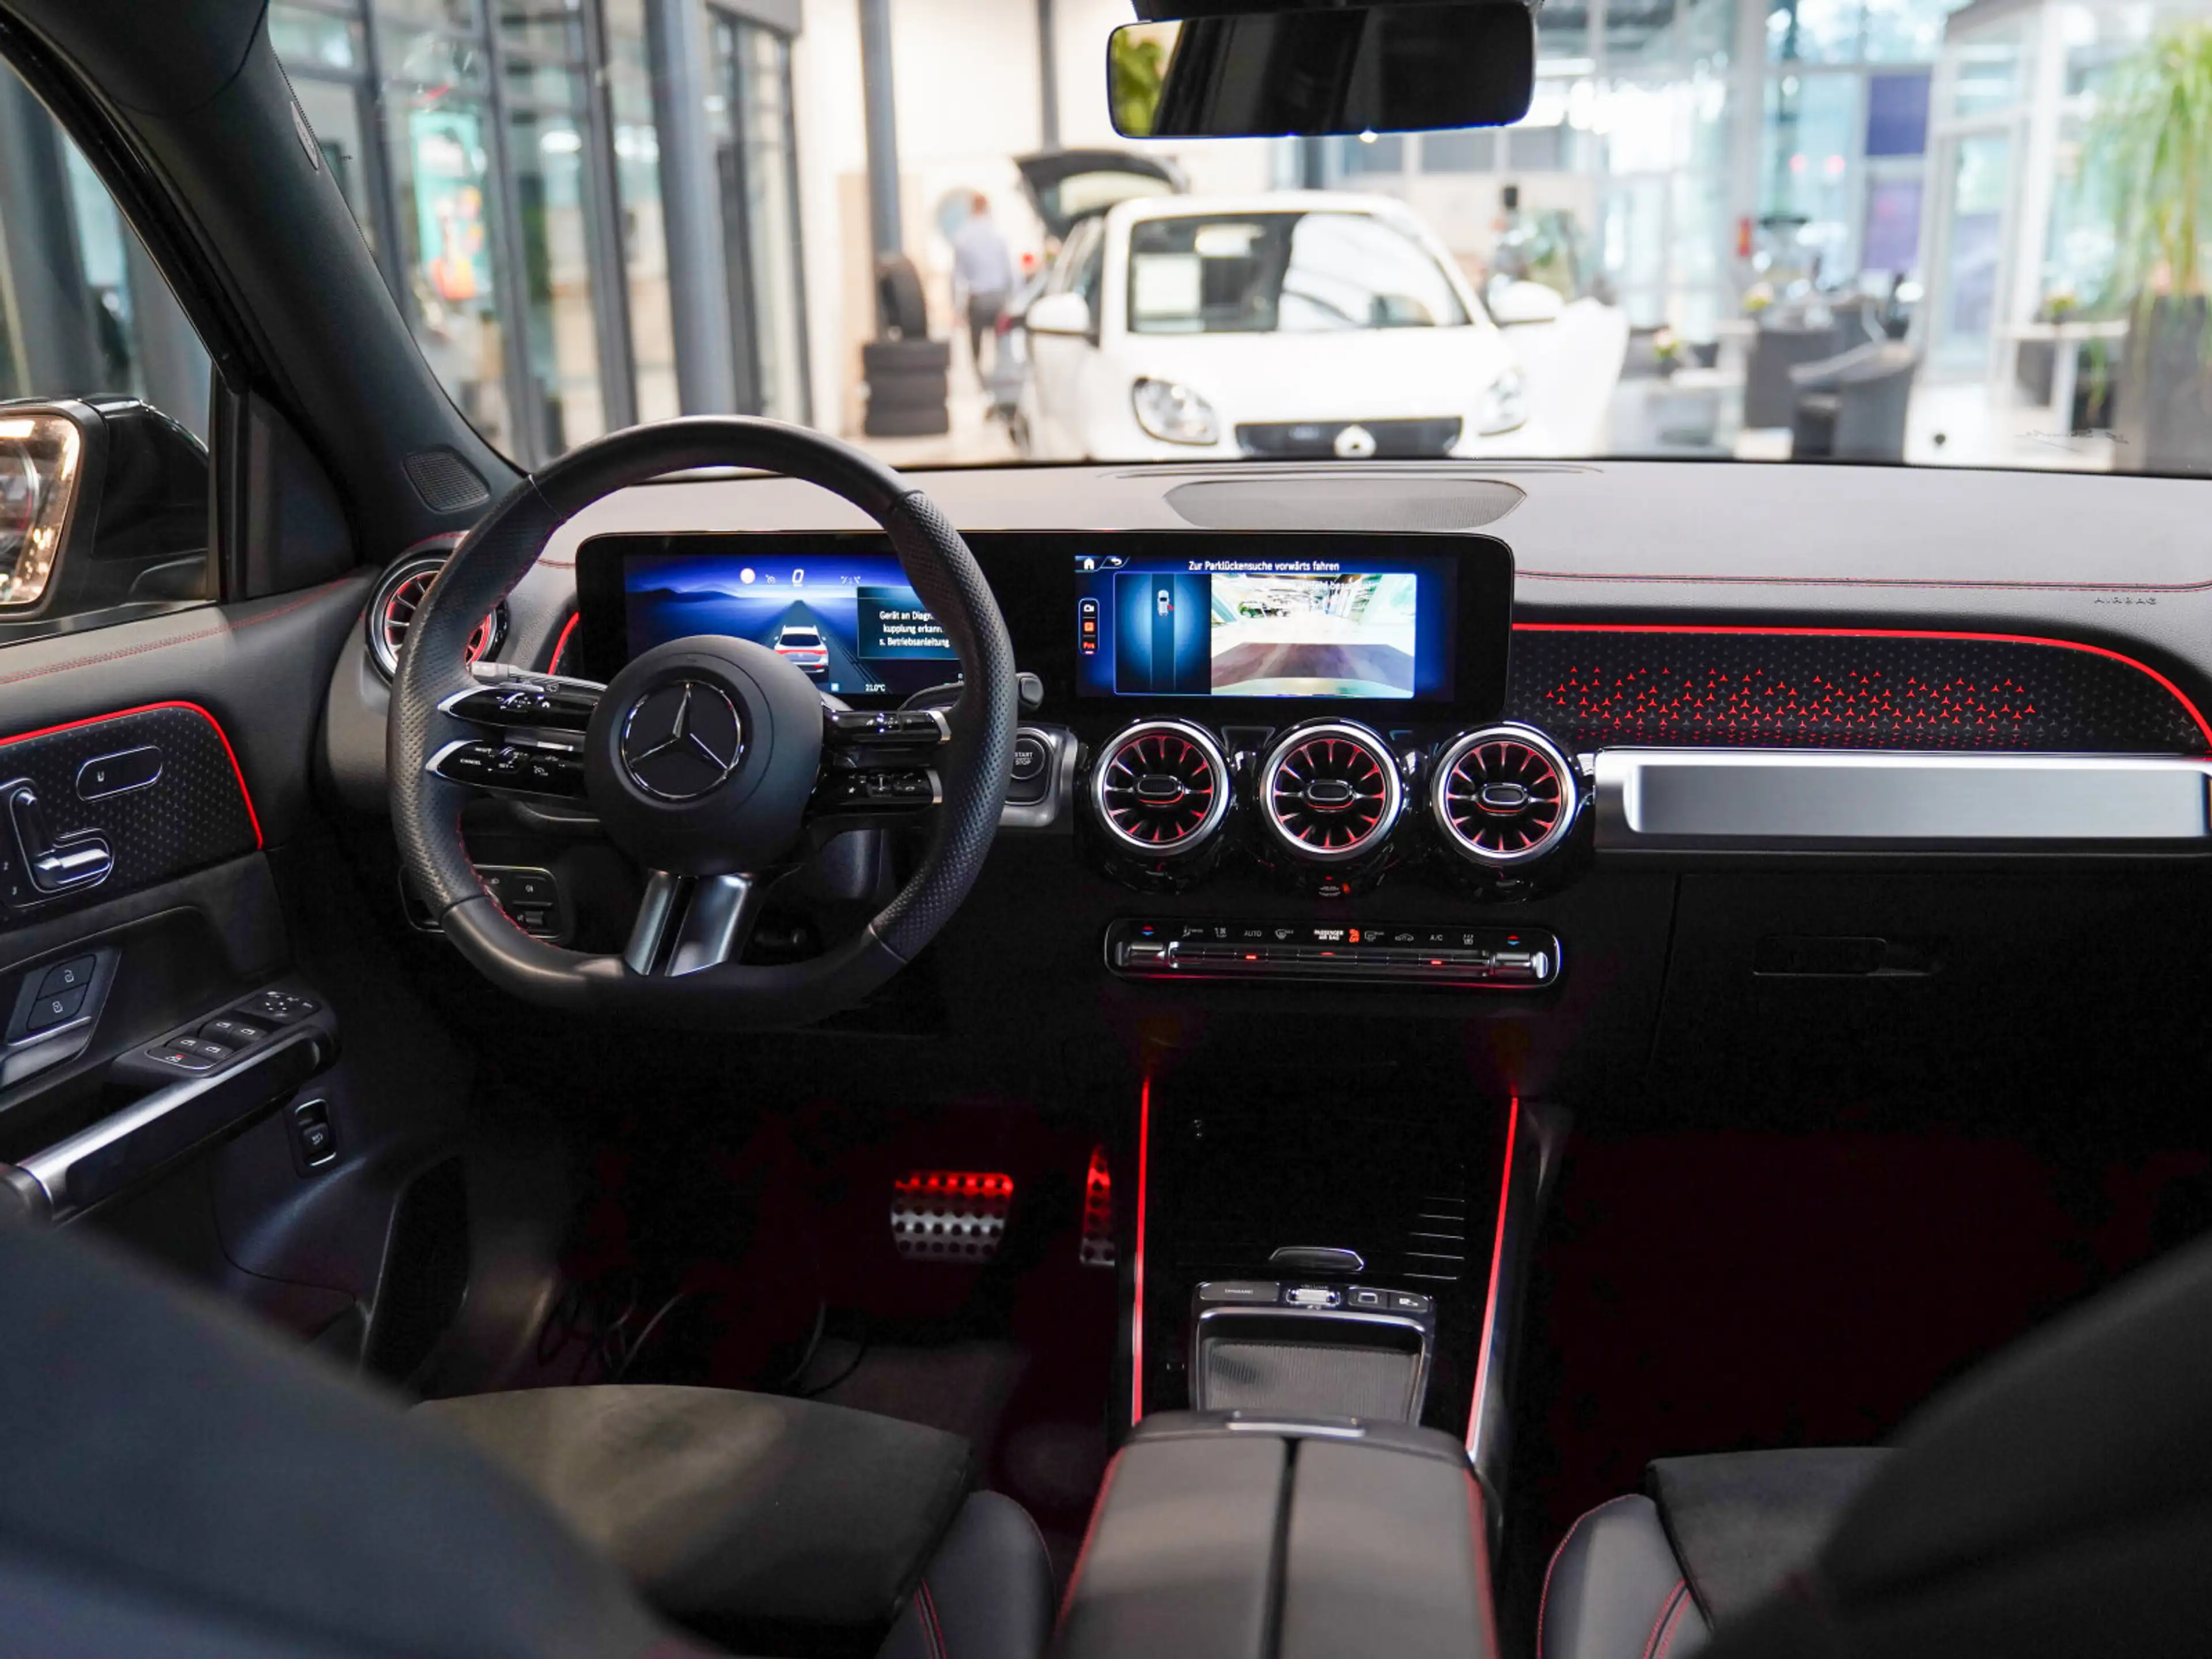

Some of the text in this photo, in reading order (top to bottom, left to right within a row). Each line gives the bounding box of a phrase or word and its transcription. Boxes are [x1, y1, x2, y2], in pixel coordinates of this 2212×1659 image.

[1188, 560, 1339, 571] Zur Parklückensuche vorwärts fahren
[879, 610, 900, 620] Gerät
[883, 624, 916, 635] kupplung
[879, 638, 886, 646] s.
